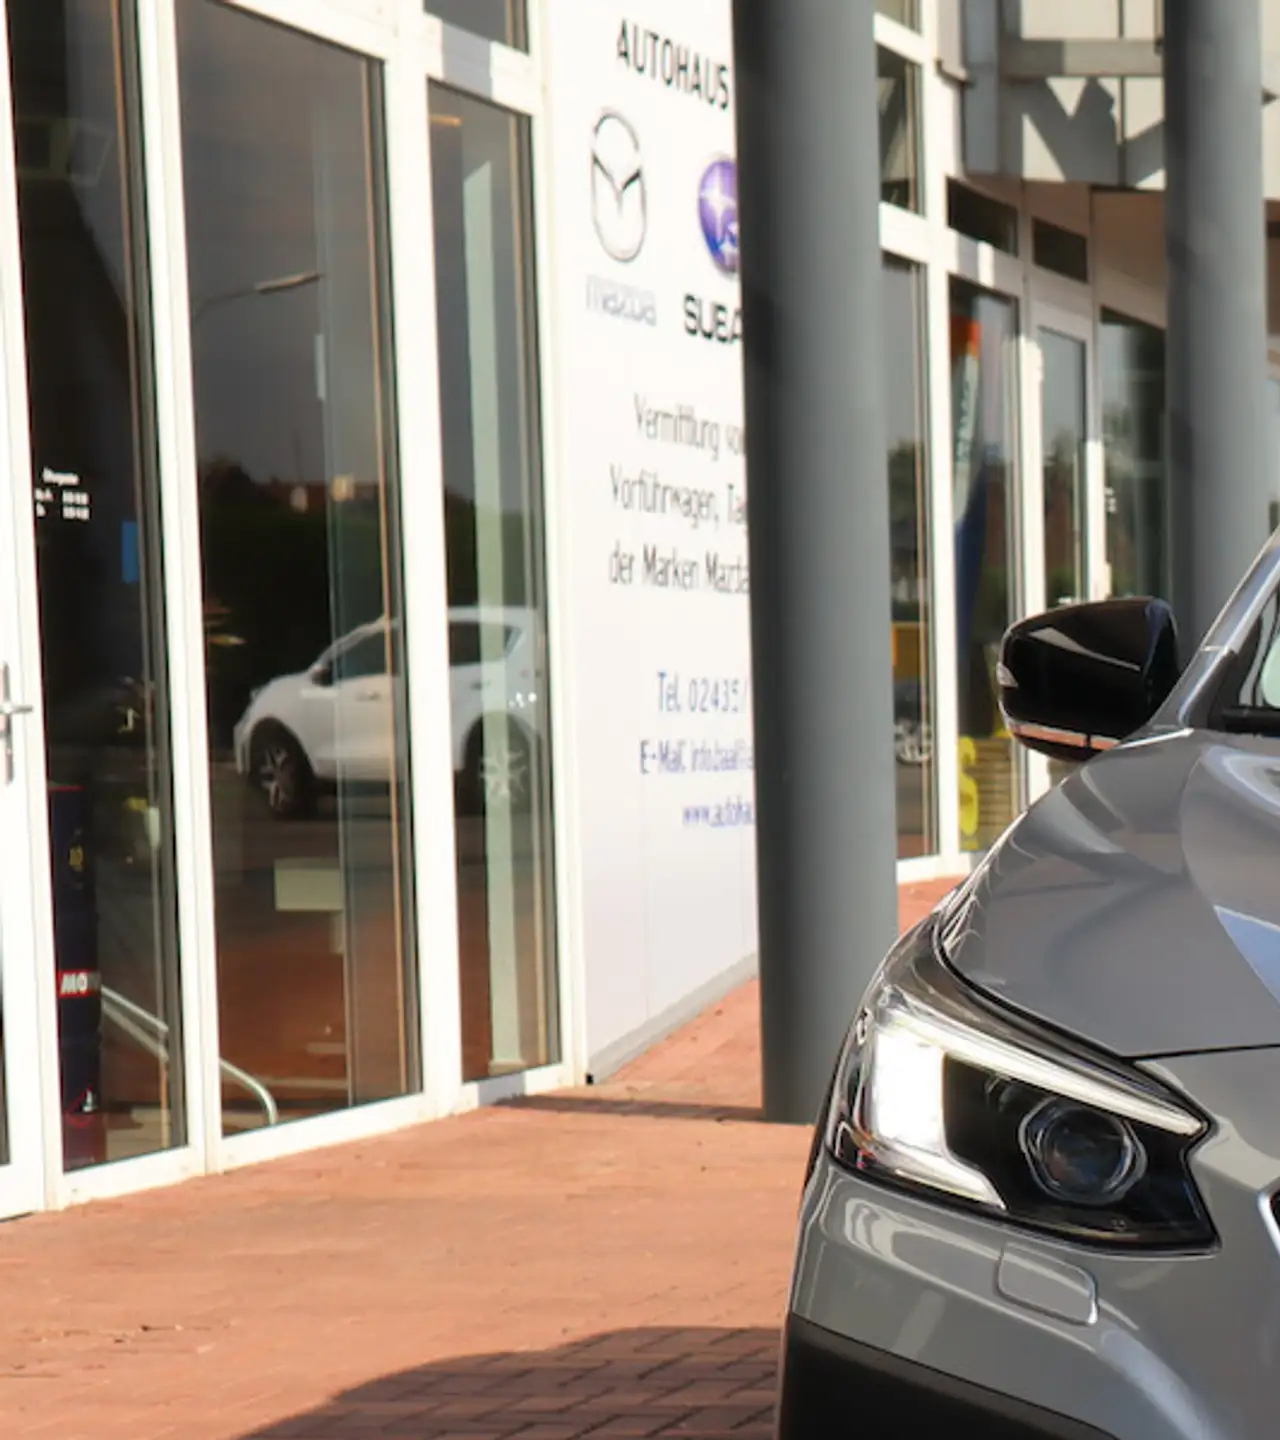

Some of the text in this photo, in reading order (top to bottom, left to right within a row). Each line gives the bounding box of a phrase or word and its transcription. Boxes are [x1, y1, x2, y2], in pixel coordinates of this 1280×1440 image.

[616, 18, 730, 110] AUTOHAUS
[634, 392, 720, 462] Vermittlung
[609, 539, 635, 584] der
[641, 544, 700, 591] Marken
